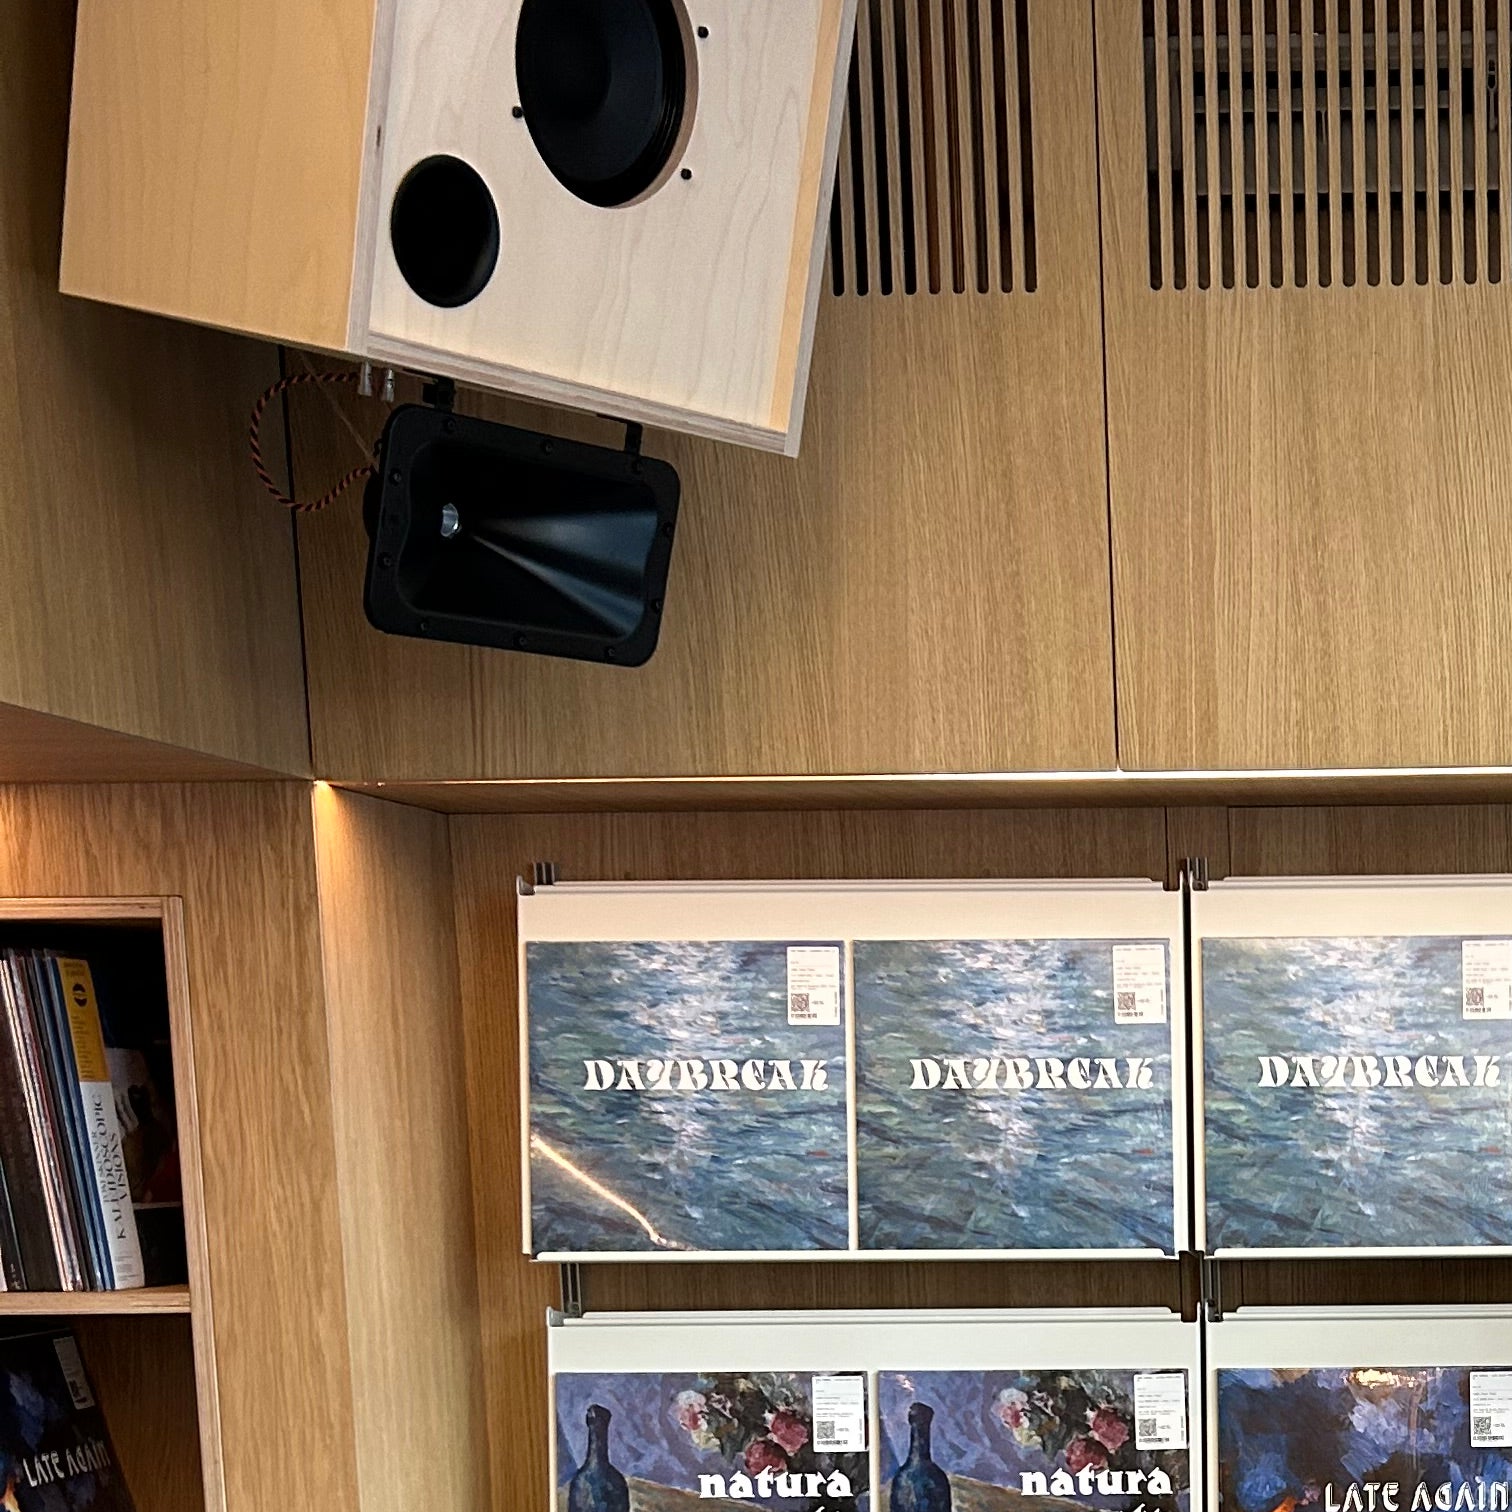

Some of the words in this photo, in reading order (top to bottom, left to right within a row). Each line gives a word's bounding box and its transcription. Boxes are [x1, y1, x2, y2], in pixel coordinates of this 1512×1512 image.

[582, 1059, 830, 1091] DAYBREAK
[909, 1057, 1155, 1090] DAYBREAK
[1257, 1054, 1502, 1088] DAYBREAK
[110, 1132, 128, 1200] VISIONS
[22, 1450, 65, 1487] LATE
[697, 1465, 854, 1499] natura
[1019, 1462, 1174, 1496] natura
[1324, 1481, 1400, 1512] LATE
[1410, 1476, 1510, 1512] AGAIN
